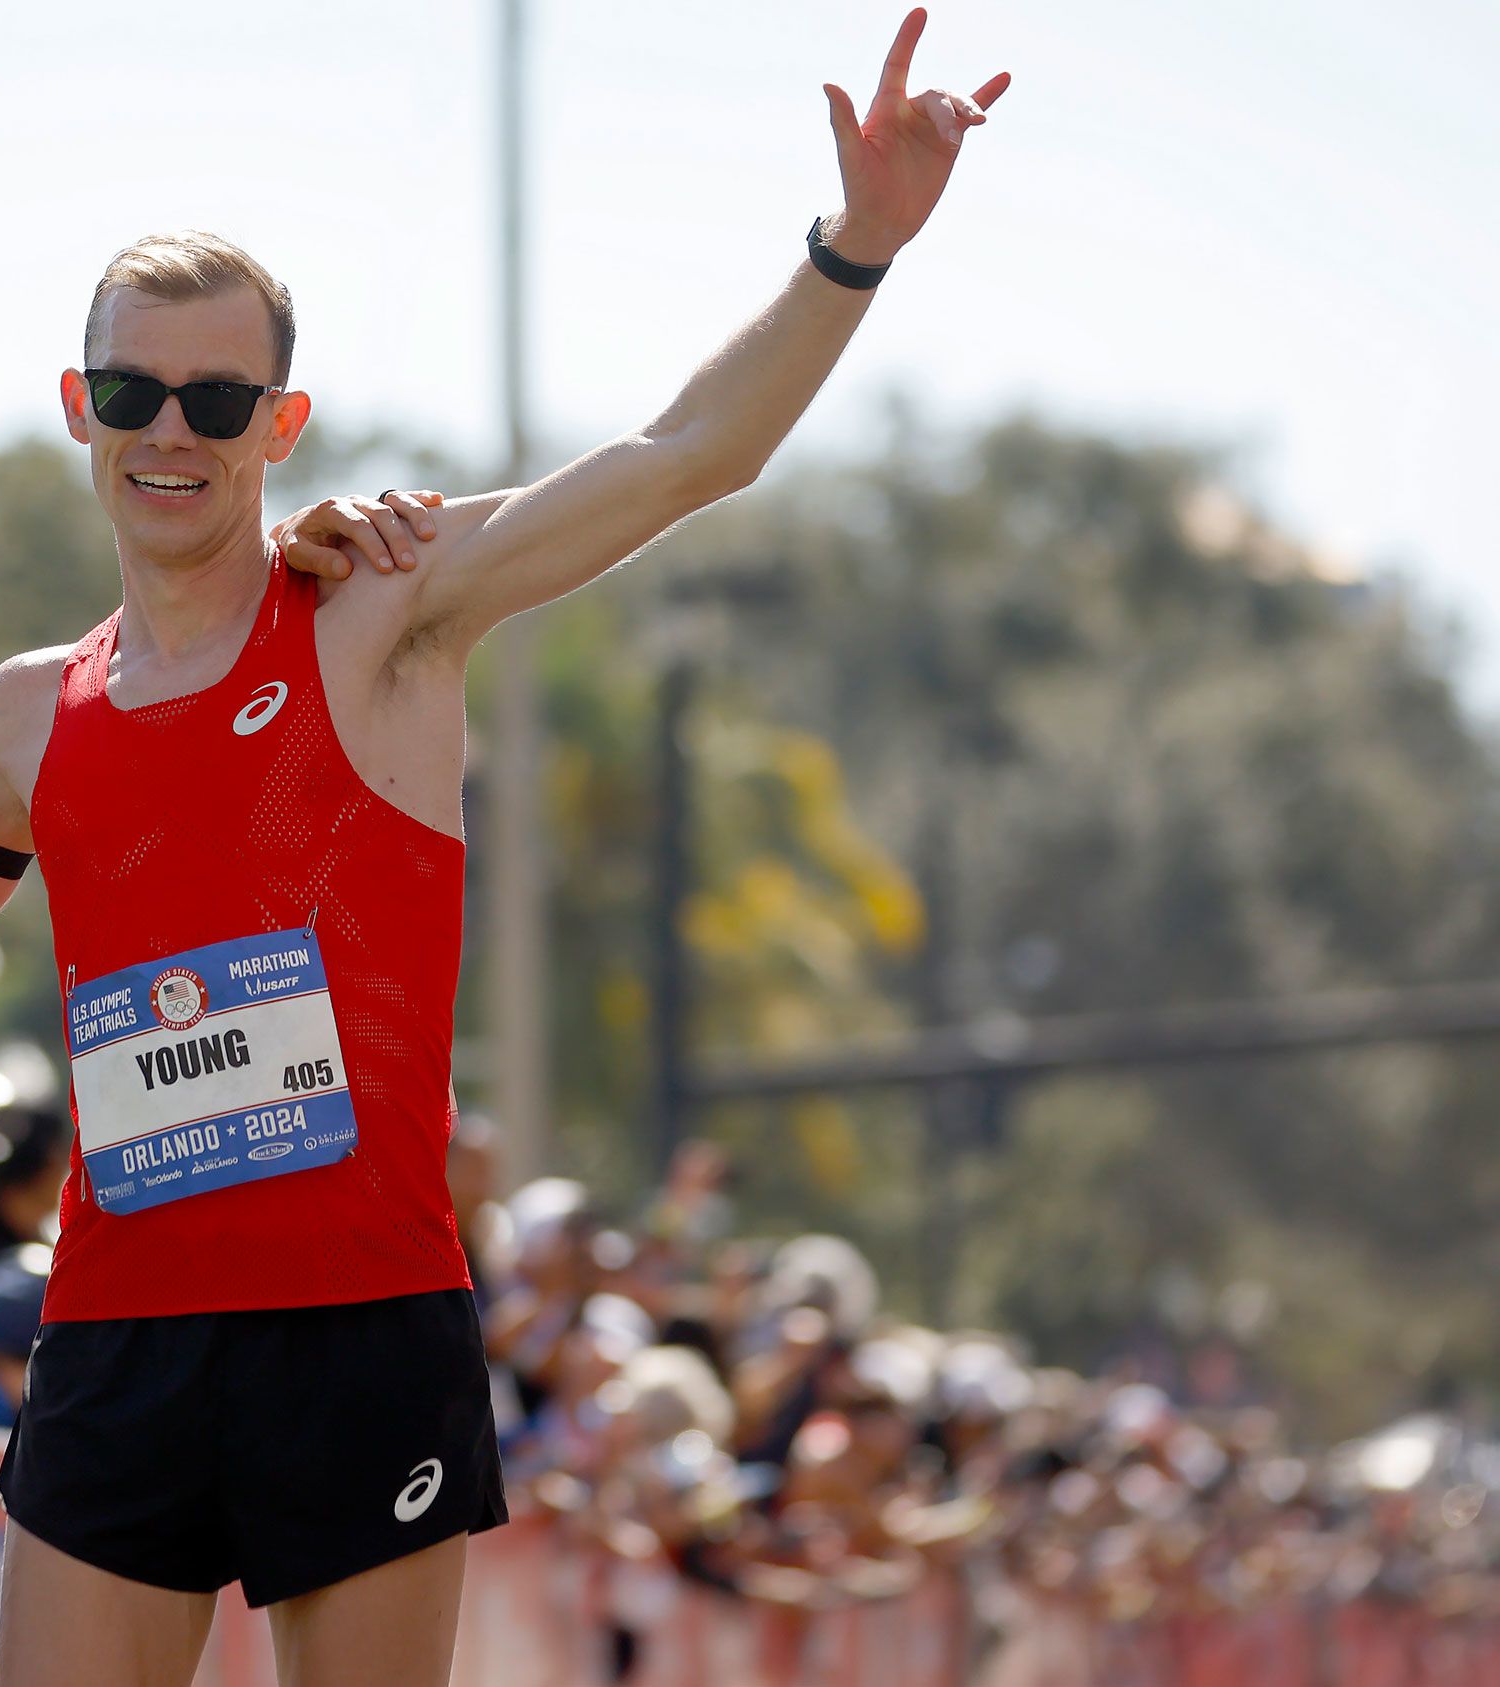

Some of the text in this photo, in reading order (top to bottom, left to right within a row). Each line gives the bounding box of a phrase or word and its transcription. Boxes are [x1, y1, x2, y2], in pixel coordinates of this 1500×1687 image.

[152, 967, 198, 992] UNITED STATES
[228, 948, 310, 980] MARATHON
[261, 976, 300, 993] USATF
[72, 987, 132, 1024] U.S. OLYMPIC
[159, 1008, 206, 1030] OLYMPIC TEAM
[73, 1006, 138, 1045] TEAM TRIALS
[135, 1028, 251, 1091] YOUNG
[282, 1058, 335, 1093] 405
[121, 1104, 308, 1175] ORLANDO 2024
[318, 1131, 356, 1145] ORLANDO
[204, 1156, 239, 1172] ORLANDO
